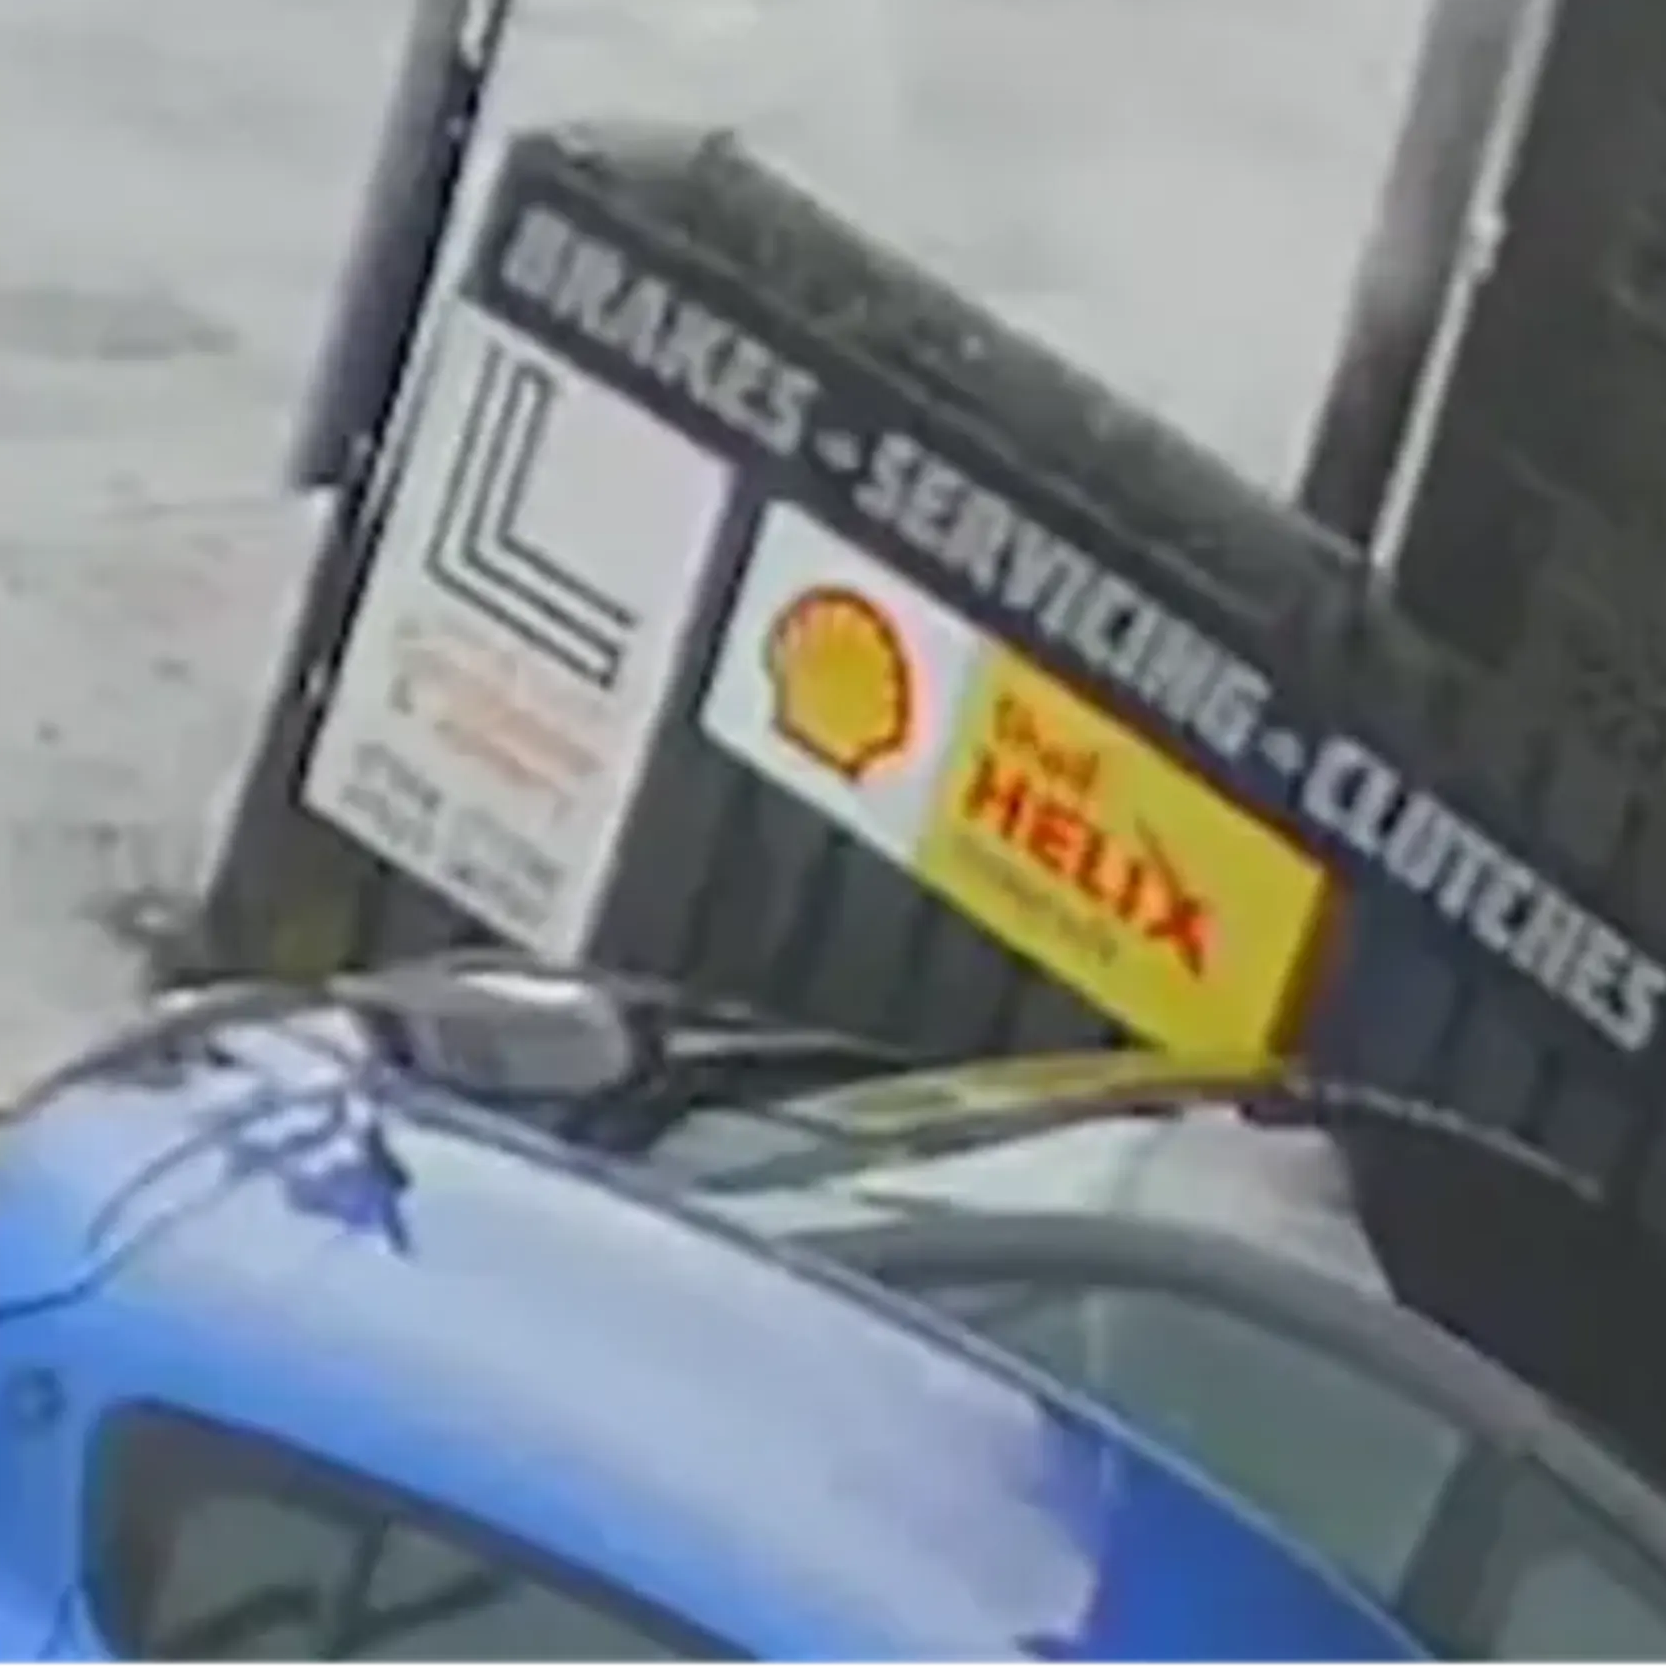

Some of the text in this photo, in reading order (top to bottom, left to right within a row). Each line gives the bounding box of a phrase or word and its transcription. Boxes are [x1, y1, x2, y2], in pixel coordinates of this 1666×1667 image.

[502, 202, 819, 456] BRAKES
[852, 432, 1273, 756] SERVICING
[963, 749, 1209, 979] HELIX
